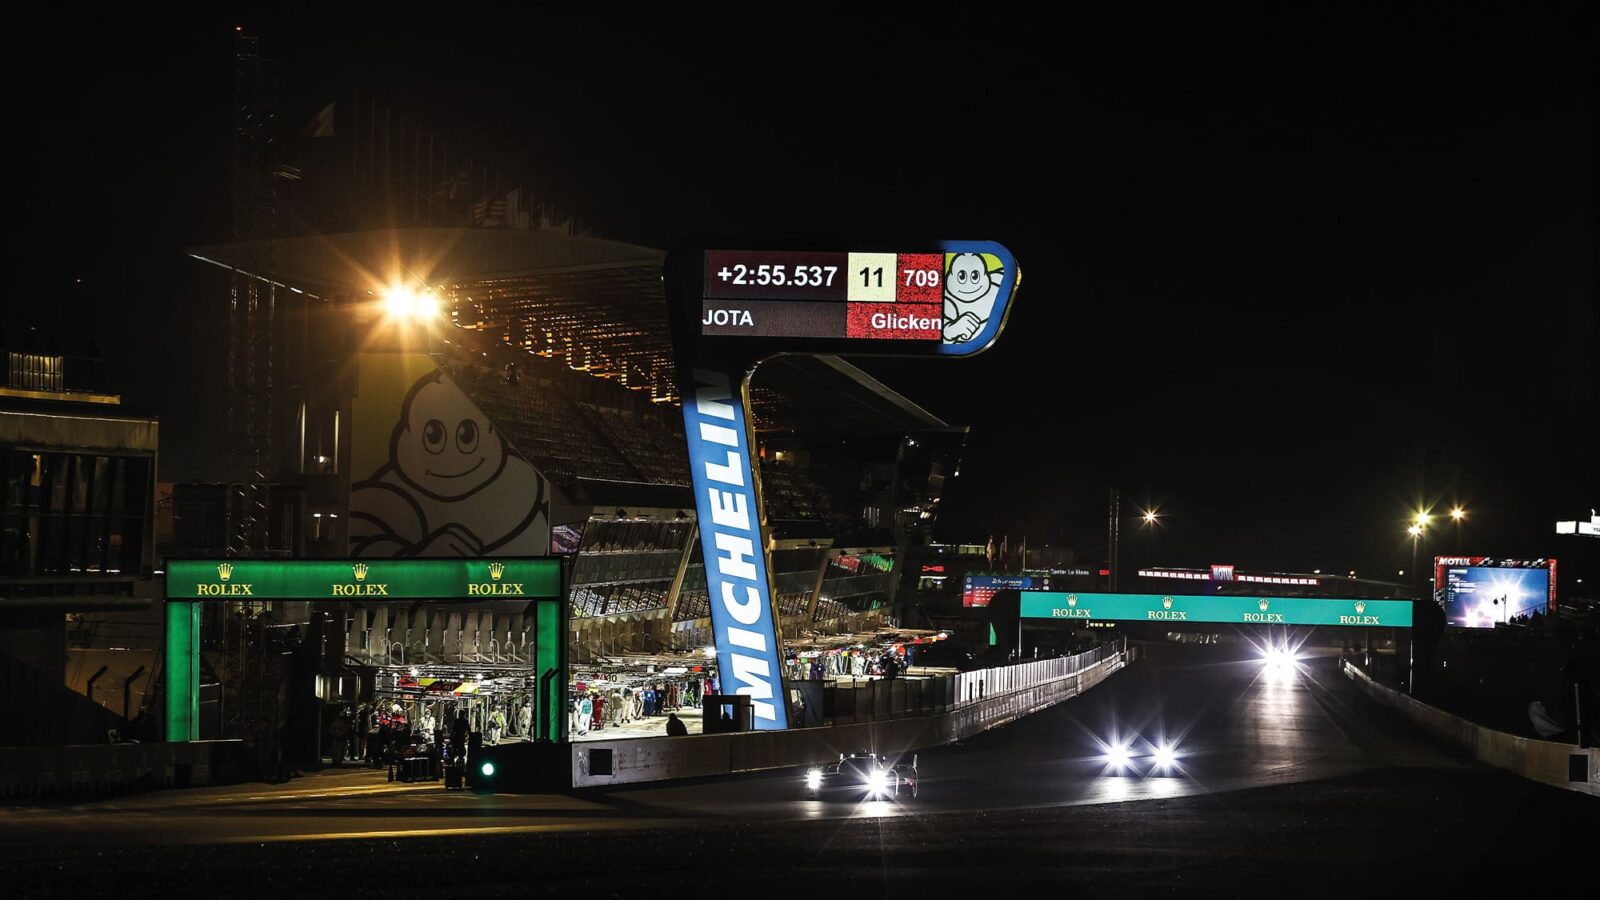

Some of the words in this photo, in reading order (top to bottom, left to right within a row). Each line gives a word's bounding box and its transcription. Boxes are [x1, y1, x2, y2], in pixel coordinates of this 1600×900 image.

[717, 264, 838, 288] +2:55.537
[859, 267, 884, 287] 11
[903, 269, 939, 287] 709
[702, 310, 754, 326] JOTA
[871, 313, 942, 332] Glicken
[692, 366, 776, 722] MICHELIN
[1439, 557, 1472, 566] MOTUL
[198, 583, 253, 596] ROLEX
[333, 583, 388, 596] ROLEX
[468, 582, 524, 595] ROLEX
[1053, 609, 1091, 618] ROLEX
[1147, 611, 1187, 621] ROLEX
[1243, 613, 1282, 623] ROLEX
[1340, 615, 1379, 625] ROLEX
